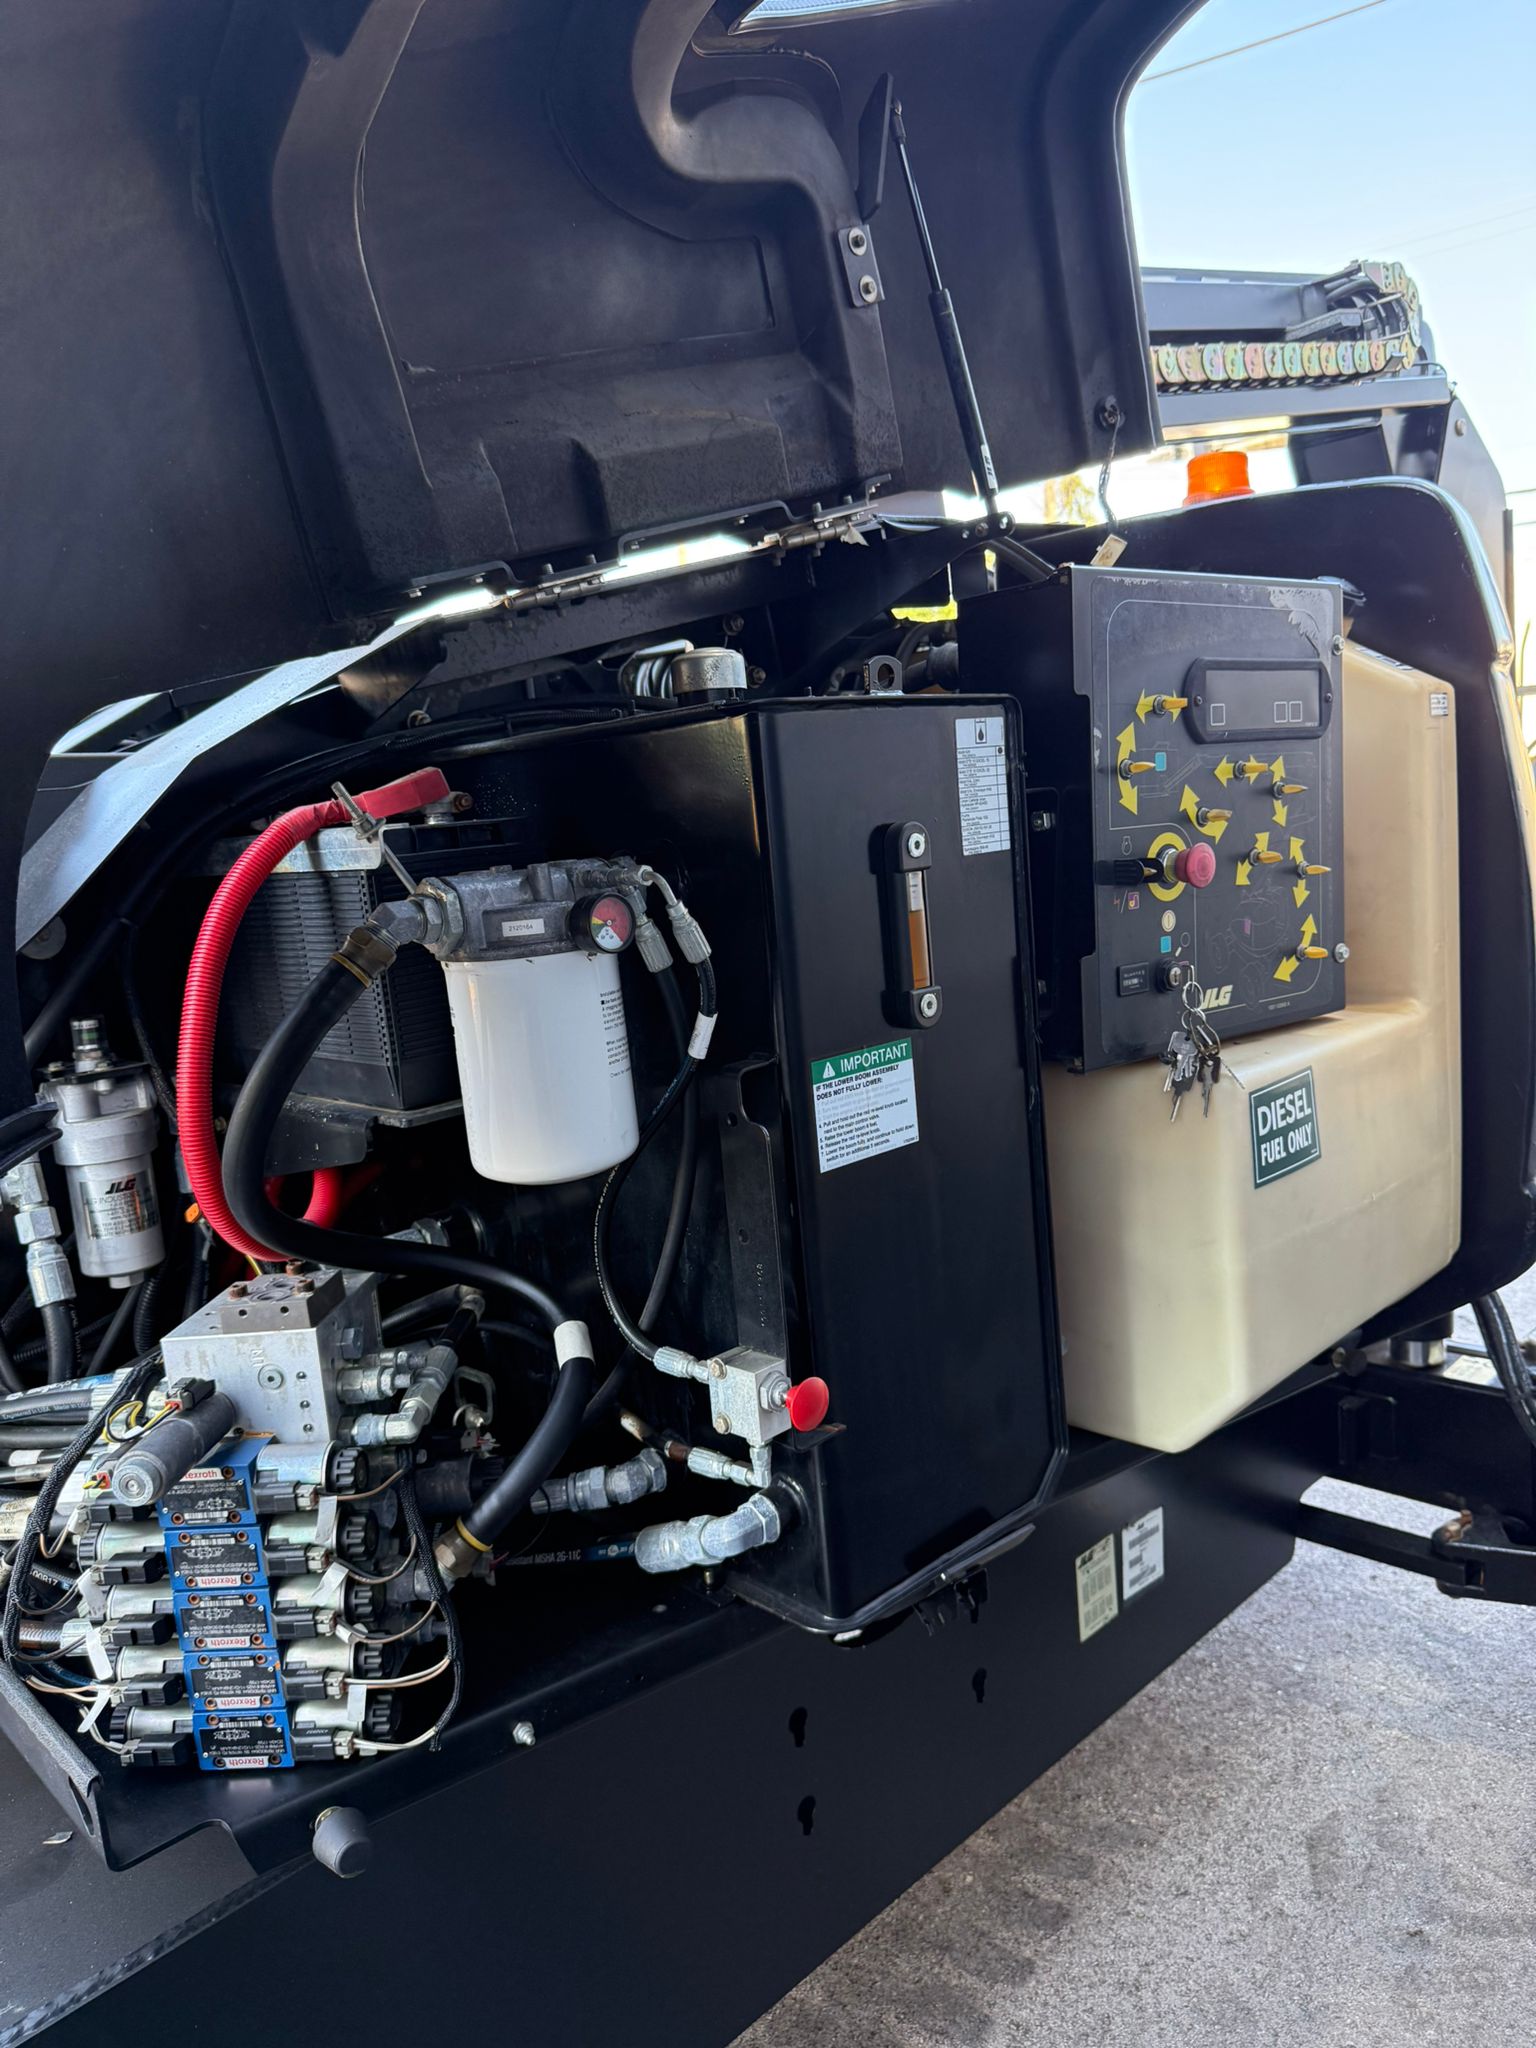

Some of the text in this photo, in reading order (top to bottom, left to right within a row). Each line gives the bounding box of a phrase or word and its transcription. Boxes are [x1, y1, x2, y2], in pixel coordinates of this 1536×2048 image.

[1200, 984, 1233, 1010] JLG
[841, 1043, 907, 1073] IMPORTANT
[822, 1083, 833, 1091] THE
[834, 1077, 853, 1087] LOWER
[854, 1072, 871, 1081] BOOM
[872, 1064, 899, 1076] ASSEMBLY
[816, 1077, 882, 1101] DOES NOT FULLY LOWER:
[1257, 1087, 1312, 1137] DIESEL
[1260, 1121, 1312, 1167] FUEL ONLY
[105, 1177, 136, 1194] JLG
[183, 1469, 218, 1480] exroth
[201, 1575, 237, 1586] Rexroth
[210, 1637, 246, 1647] Rexroth
[220, 1697, 257, 1706] Rexroth
[229, 1757, 264, 1766] Rexroth
